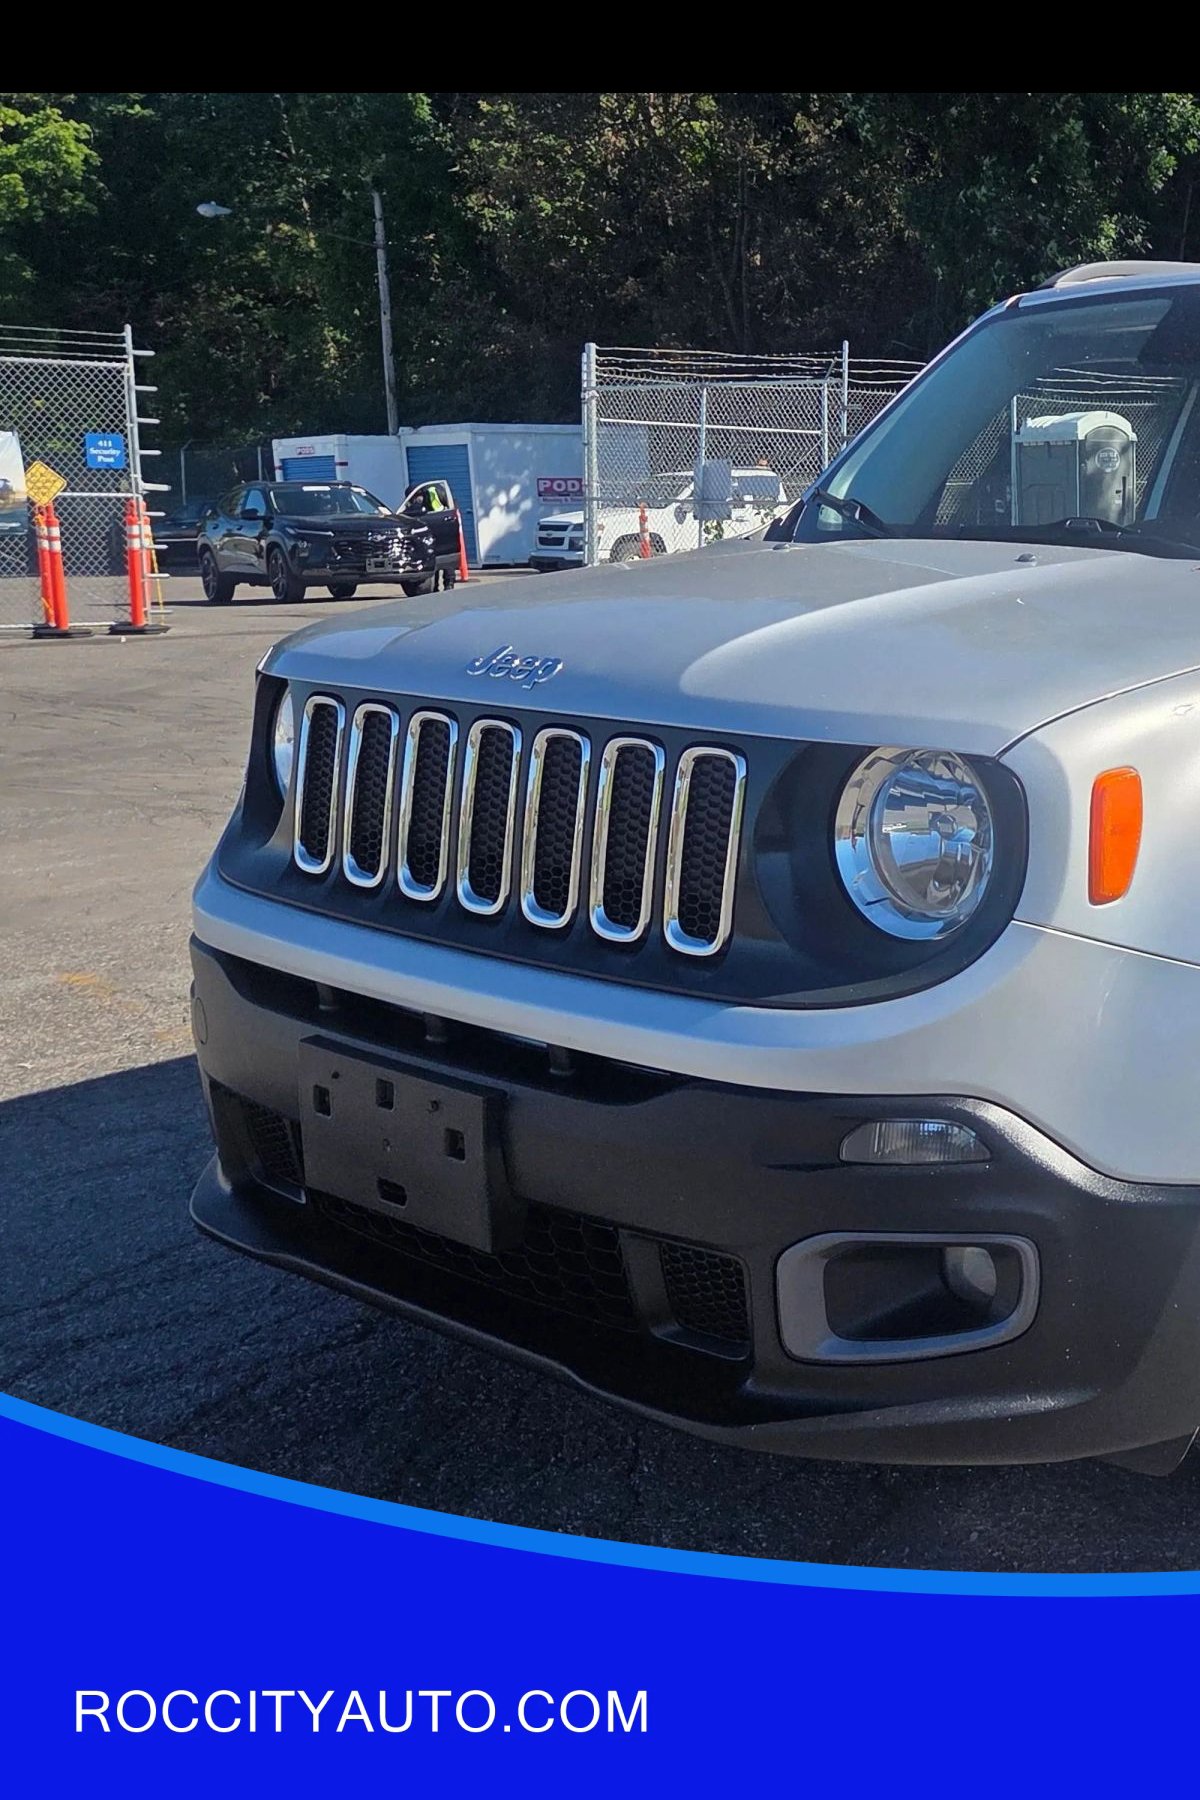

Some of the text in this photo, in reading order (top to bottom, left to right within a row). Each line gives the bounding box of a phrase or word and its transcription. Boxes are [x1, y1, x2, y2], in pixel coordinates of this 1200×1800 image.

[89, 447, 121, 457] Security
[538, 480, 585, 492] POD
[466, 645, 564, 690] Jeep
